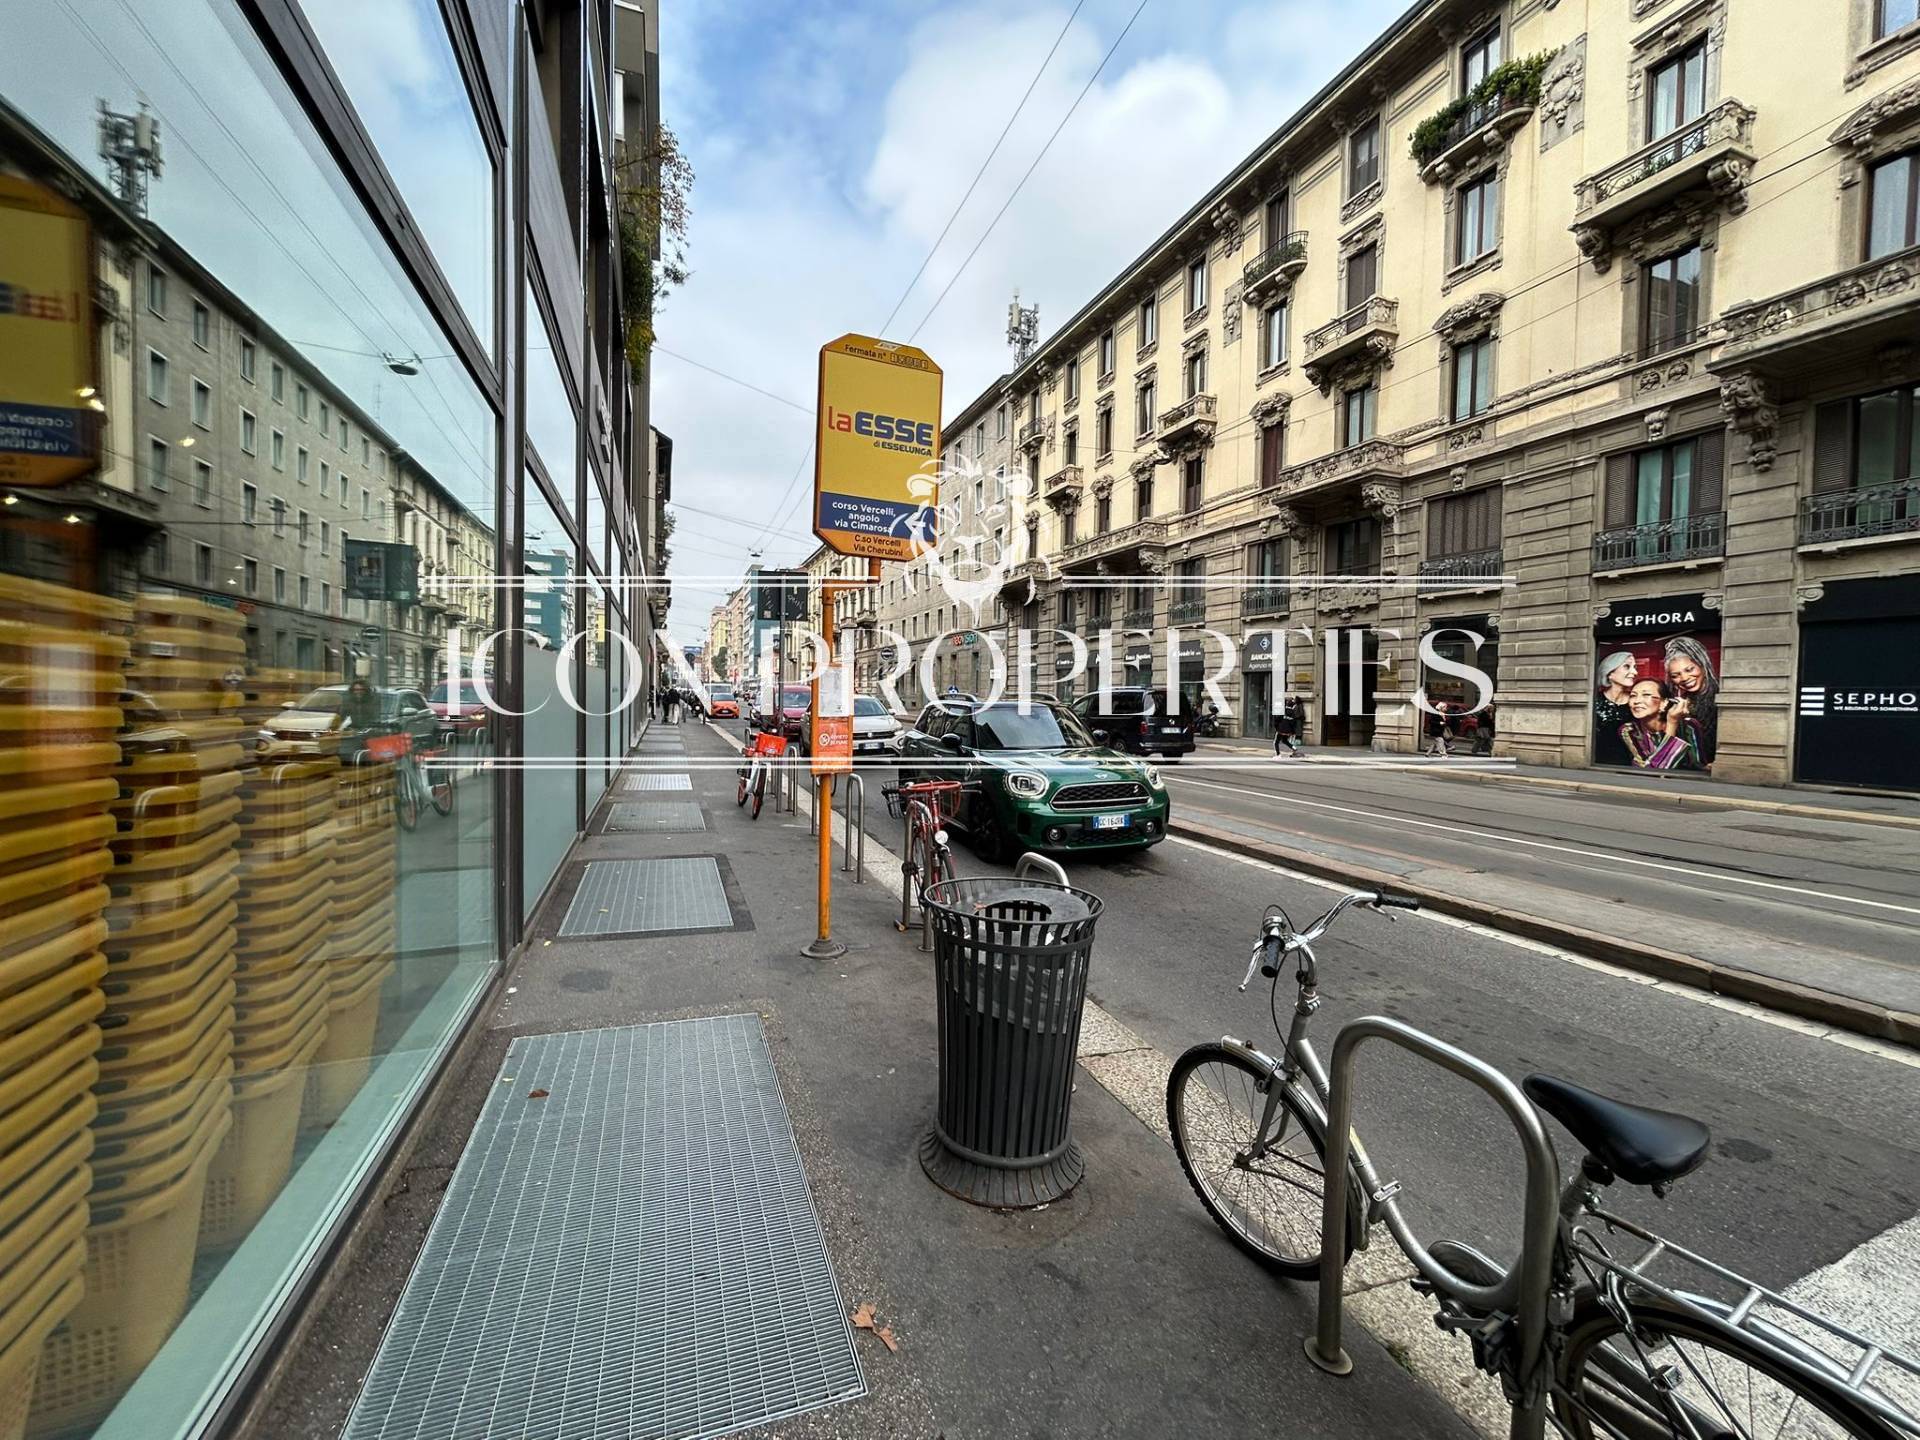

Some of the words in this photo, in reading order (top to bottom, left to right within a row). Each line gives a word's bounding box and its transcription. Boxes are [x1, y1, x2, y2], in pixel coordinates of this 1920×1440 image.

[845, 344, 876, 357] Fermata
[881, 442, 932, 457] ESSELUNGA
[832, 501, 858, 511] corso
[861, 504, 896, 517] Vercelli,
[834, 519, 848, 528] via
[848, 513, 880, 523] angolo
[854, 544, 865, 552] Via
[1615, 611, 1695, 627] SEPHORA
[1833, 693, 1917, 705] SEPHO
